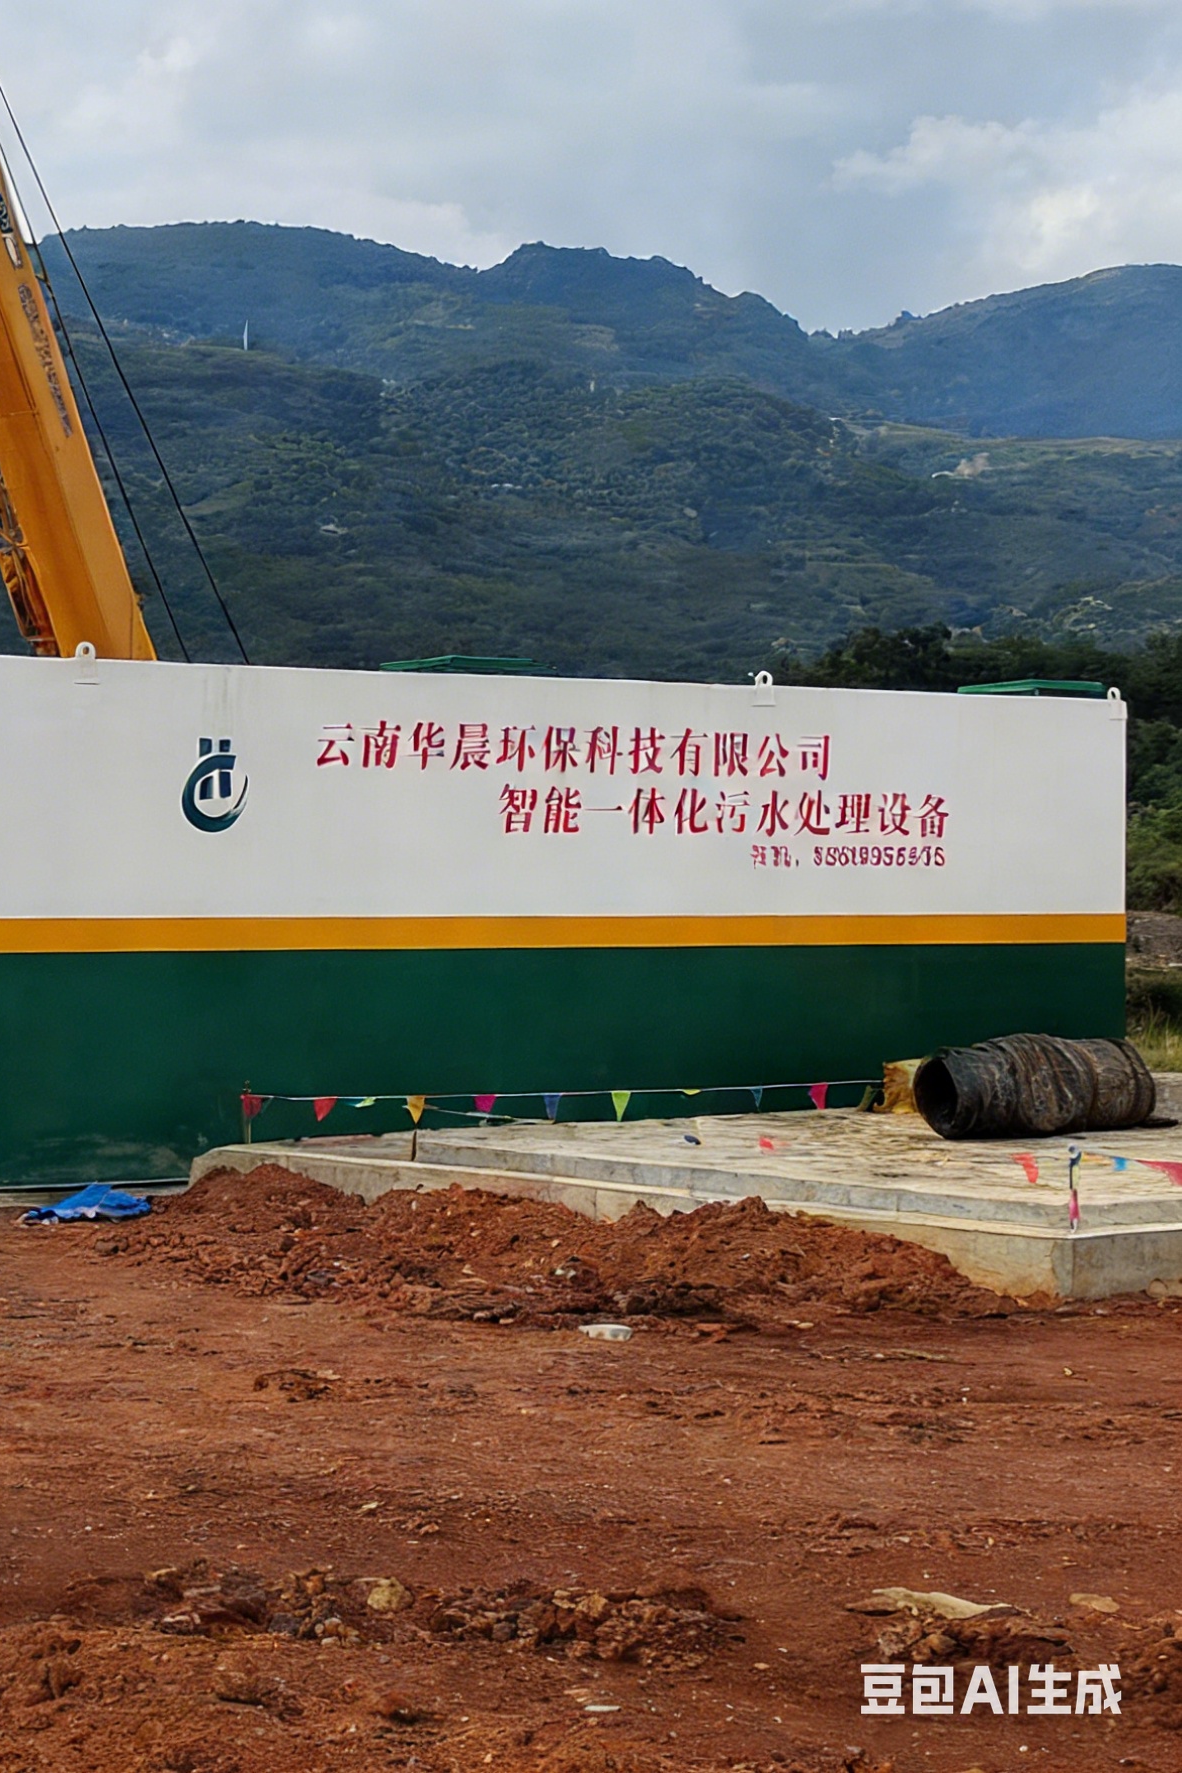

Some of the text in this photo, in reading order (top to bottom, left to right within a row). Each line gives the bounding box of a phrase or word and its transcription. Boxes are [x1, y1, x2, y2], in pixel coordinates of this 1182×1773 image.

[316, 720, 831, 780] 云南华晨环保科技有限公司
[498, 784, 950, 838] 智能一体化污水处理设备
